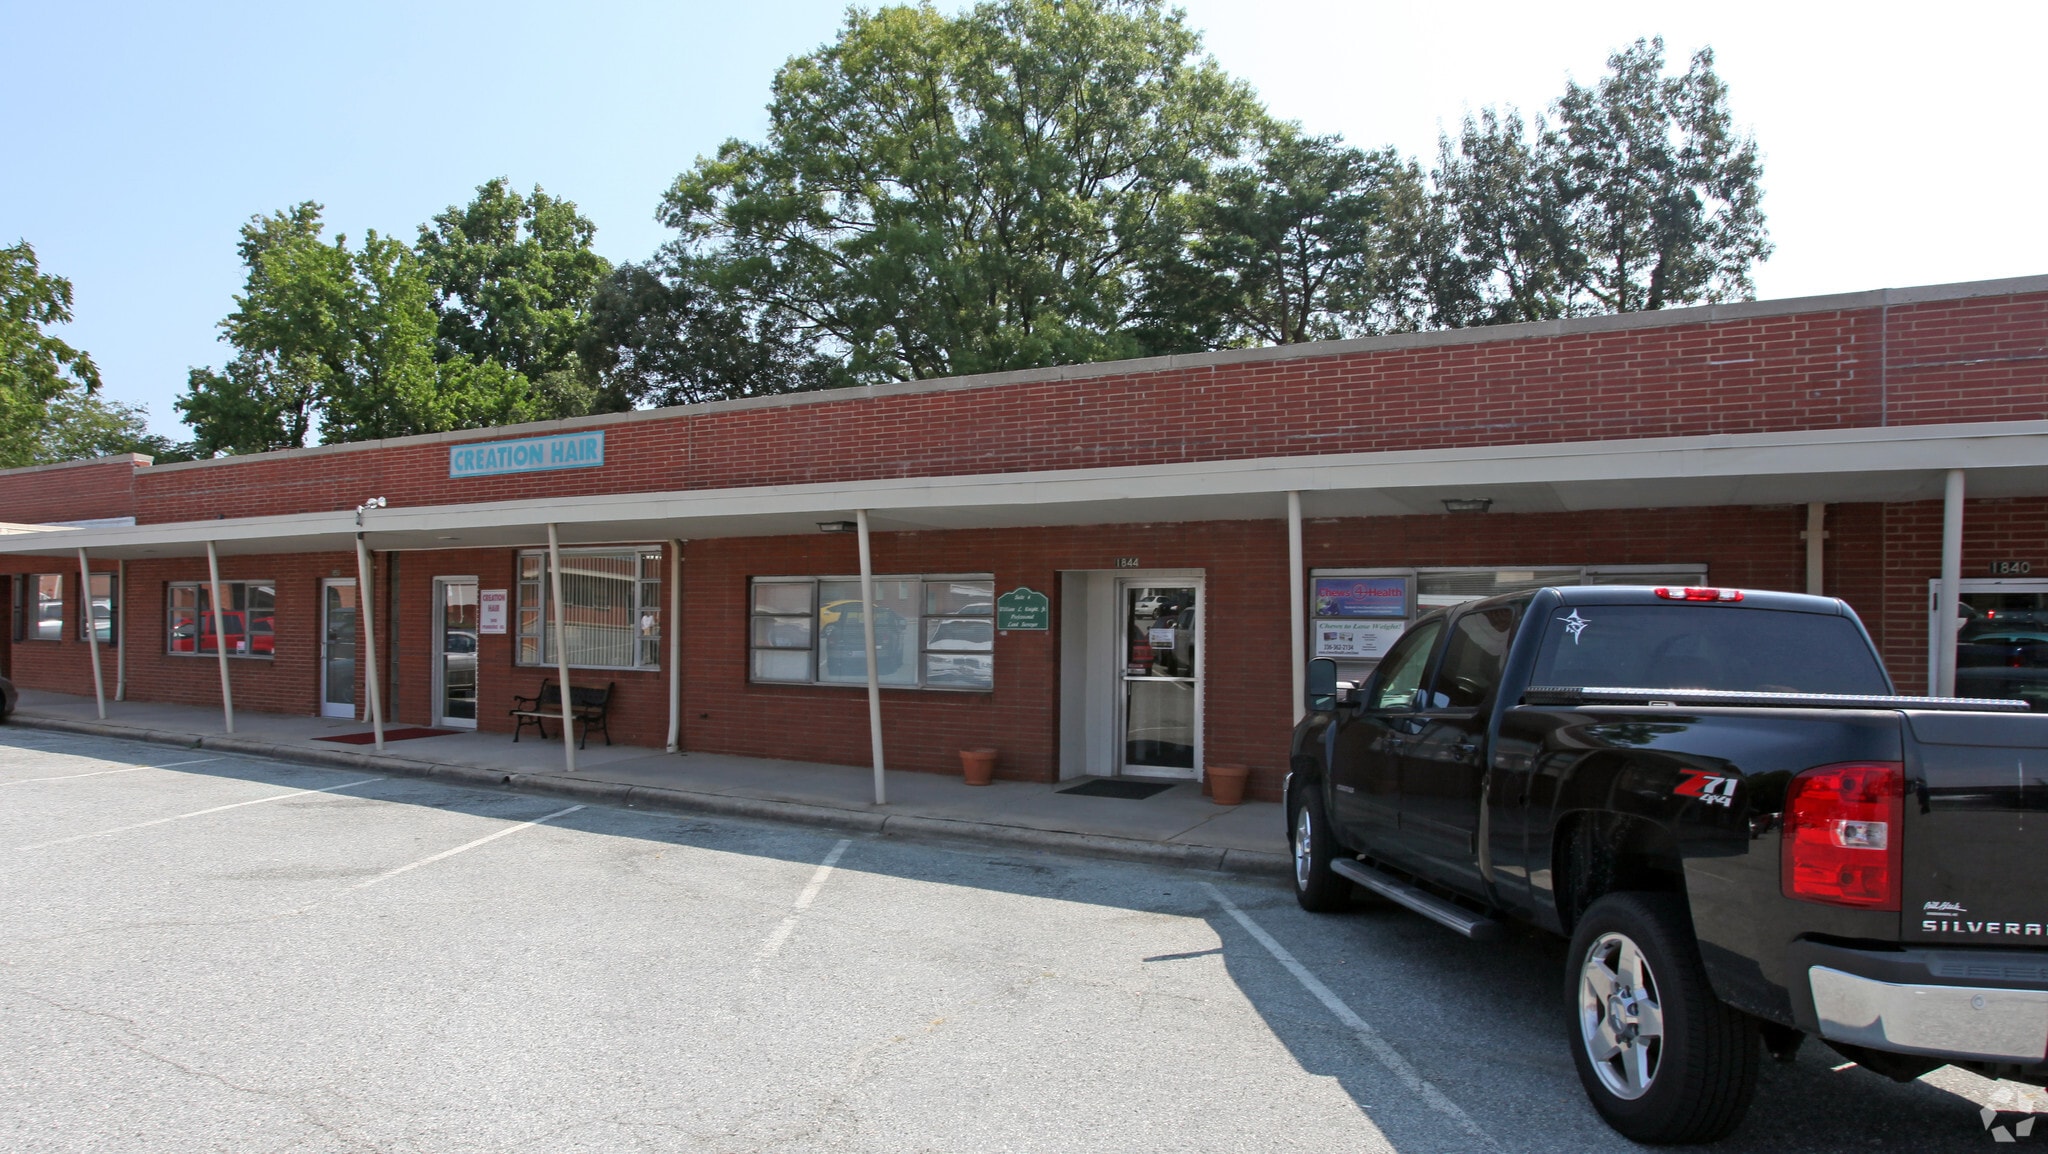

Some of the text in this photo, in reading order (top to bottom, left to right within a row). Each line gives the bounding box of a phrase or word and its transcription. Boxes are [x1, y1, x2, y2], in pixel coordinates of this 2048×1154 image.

[454, 437, 598, 472] CREATION HAIR
[1115, 558, 1139, 568] 1844
[1992, 561, 2031, 574] 1840
[1319, 587, 1352, 597] Chews
[1368, 587, 1402, 597] Health
[1673, 768, 1739, 797] Z71
[1922, 920, 2048, 936] SILVERA
